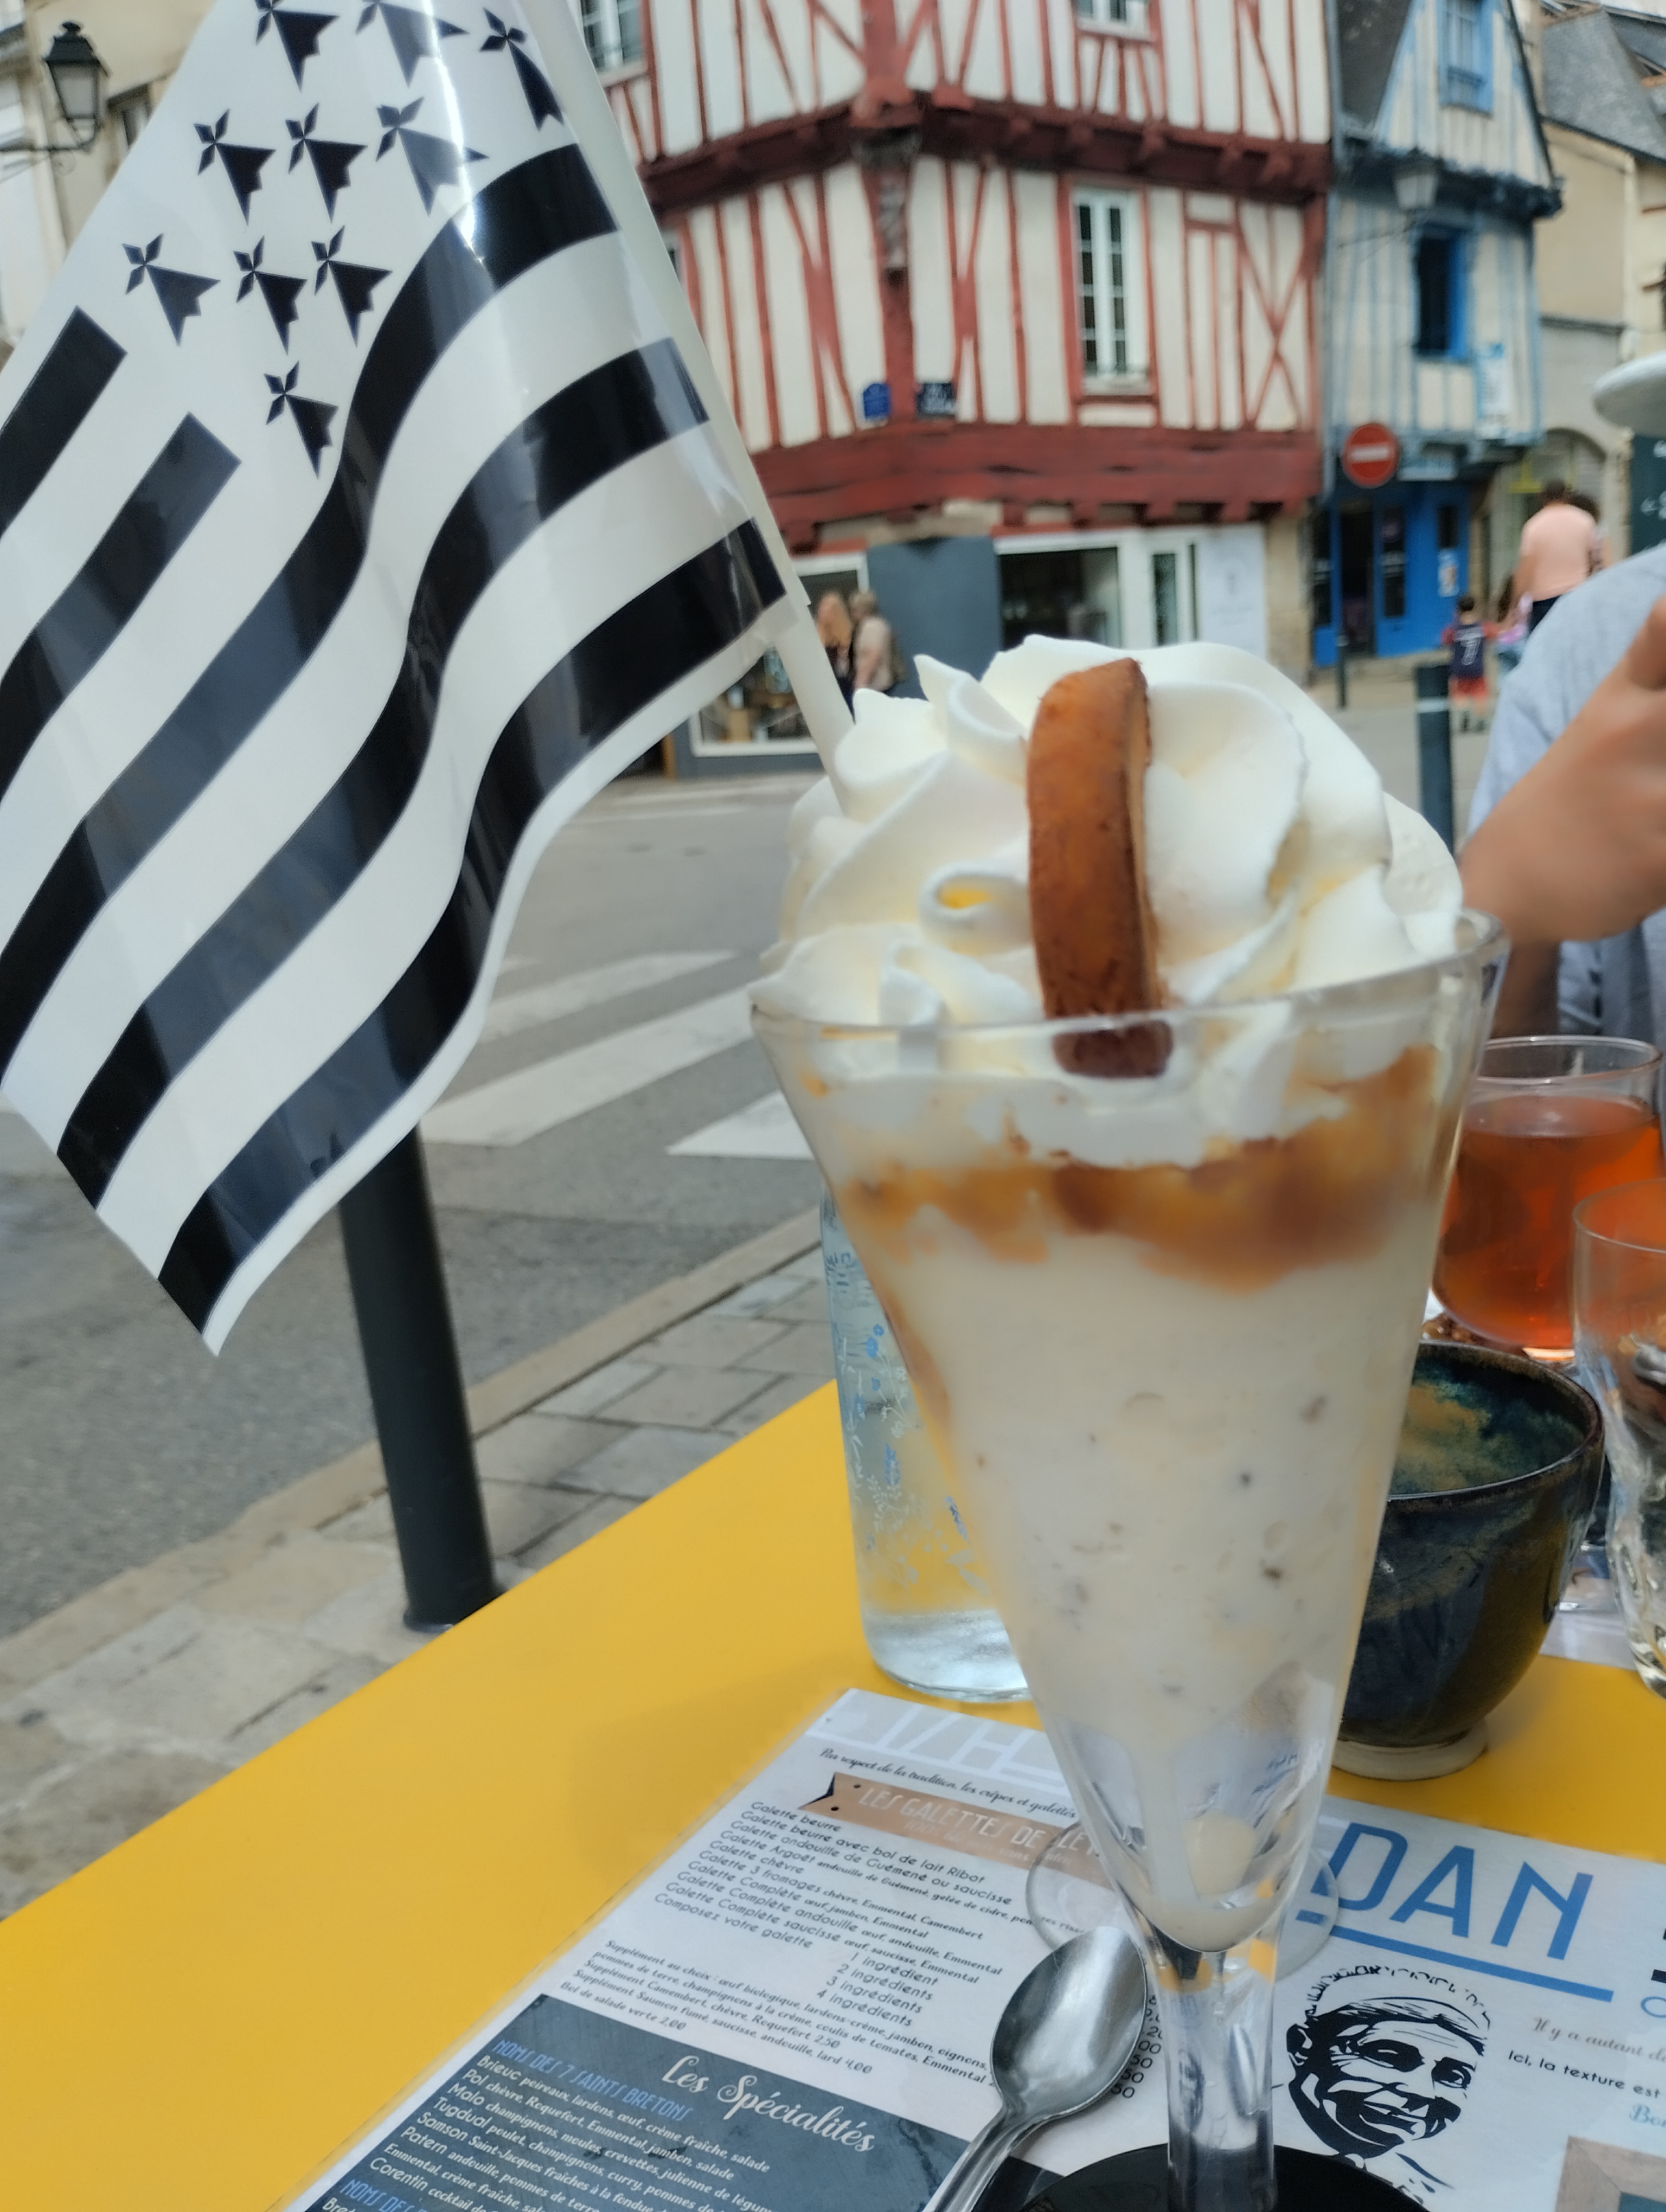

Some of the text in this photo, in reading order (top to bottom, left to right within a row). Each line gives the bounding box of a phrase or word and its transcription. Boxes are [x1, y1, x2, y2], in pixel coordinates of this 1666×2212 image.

[741, 1811, 985, 1883] Galette beurre avec bol de lait Ribot
[751, 1802, 841, 1832] Galette beurre
[858, 1787, 895, 1809] LES
[900, 1794, 1008, 1838] GALETTES
[1010, 1828, 1046, 1848] DE
[710, 1841, 804, 1874] Galette chèvre
[731, 1821, 1012, 1905] Galette andouille de Guémené ou saucisse
[1311, 1822, 1594, 1960] DAN
[655, 1893, 813, 1949] Composez votre galette
[677, 1872, 725, 1893] Galette
[794, 1909, 858, 1932] andouille
[943, 1952, 1003, 1975] Emmental
[688, 1861, 736, 1882] Galette
[873, 1917, 929, 1938] Emmental
[699, 1850, 747, 1871] Galette
[749, 1866, 761, 1875] 3
[762, 1870, 821, 1893] fromages
[920, 1916, 983, 1940] Camembert
[666, 1882, 714, 1904] Galette
[784, 1921, 841, 1941] saucisse
[920, 1960, 979, 1983] Emmental
[850, 1952, 938, 1985] 1 ingrédient
[817, 1989, 912, 2027] 4 ingrédients
[826, 1976, 922, 2014] 3 ingrédients
[836, 1964, 932, 2001] 2 ingrédients
[1508, 2050, 1661, 2099] Ici, la texture est
[1549, 2028, 1561, 2041] y
[1567, 2032, 1581, 2041] a
[1585, 2037, 1644, 2056] autant
[477, 2055, 770, 2172] Brieuc poireaux, lardons, œuf, crème fraîche, salade
[492, 2040, 693, 2121] NOMS DES 7 SAINTS BRETONS
[662, 2056, 874, 2151] Les Spécialités
[417, 2112, 468, 2141] Samson
[469, 2136, 542, 2172] Saint-Jacques
[544, 2167, 589, 2191] fraîches
[589, 2184, 599, 2195] à
[599, 2188, 611, 2200] la
[434, 2097, 492, 2128] Tugdual
[486, 2125, 526, 2146] poulet,
[529, 2142, 604, 2176] champignons,
[607, 2172, 643, 2191] curry,
[643, 2186, 696, 2209] pommes
[447, 2083, 771, 2212] Malo champignons, moules, crevettes, julienne de légum
[462, 2069, 489, 2086] Pol
[526, 2097, 584, 2127] Roquefort,
[643, 2144, 692, 2166] jambon,
[696, 2162, 734, 2181] salade
[340, 2179, 386, 2206] NOMS
[370, 2157, 428, 2191] Corentin
[428, 2189, 473, 2210] cocktail
[384, 2143, 520, 2210] Emmental, crème fraîche,
[401, 2126, 566, 2203] Patern andouille, pommes de
